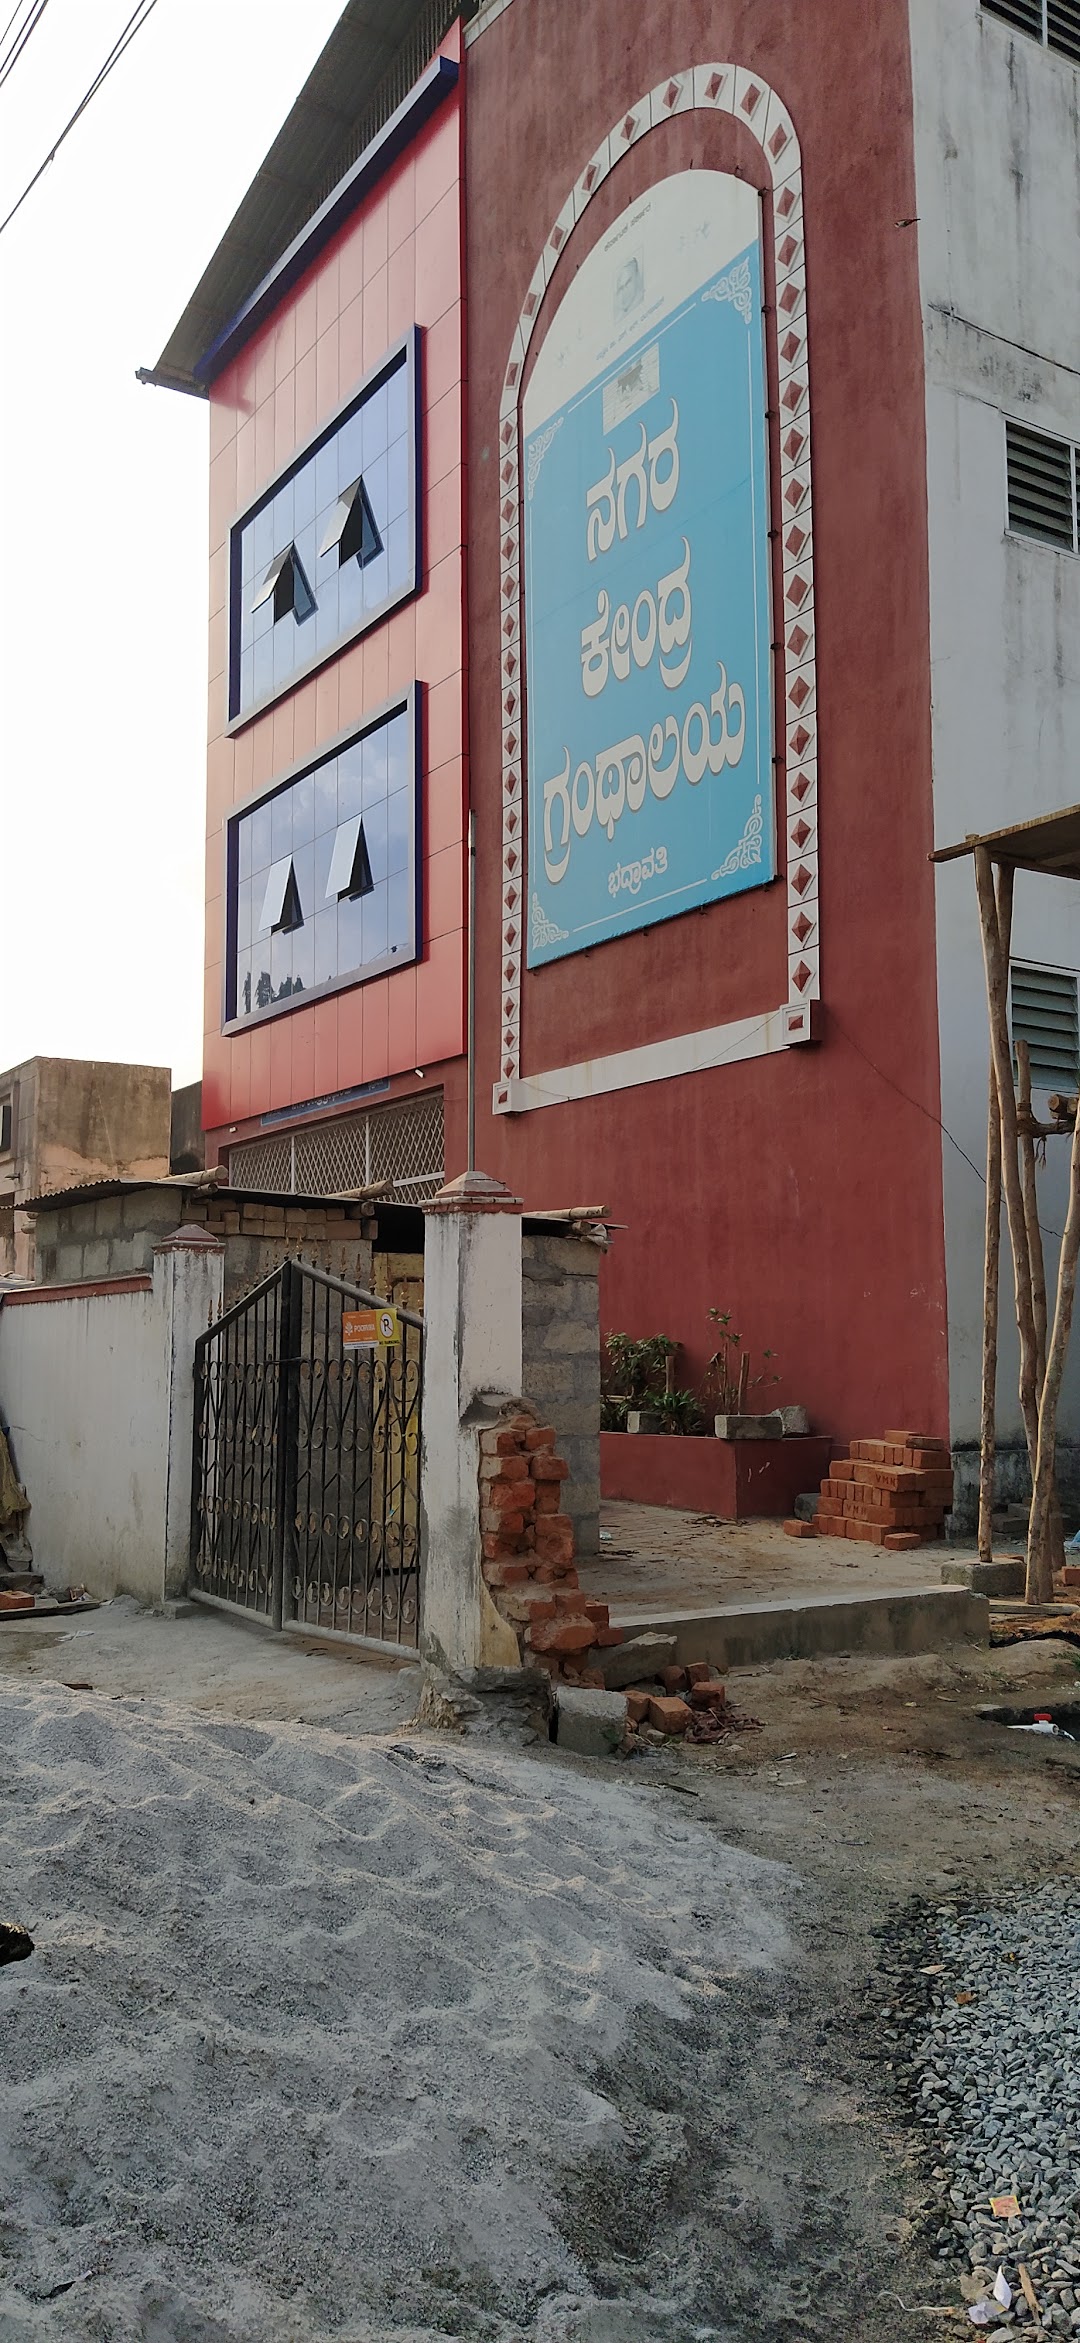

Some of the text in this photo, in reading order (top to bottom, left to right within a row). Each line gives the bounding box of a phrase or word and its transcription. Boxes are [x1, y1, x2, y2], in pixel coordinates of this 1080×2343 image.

[586, 397, 680, 562] ನಗರ
[580, 536, 693, 697] ಕೇಂದ್ರ
[543, 661, 746, 884] ಗ್ರಂಥಾಲಯ
[608, 846, 668, 898] ಭದ್ರಾವತಿ
